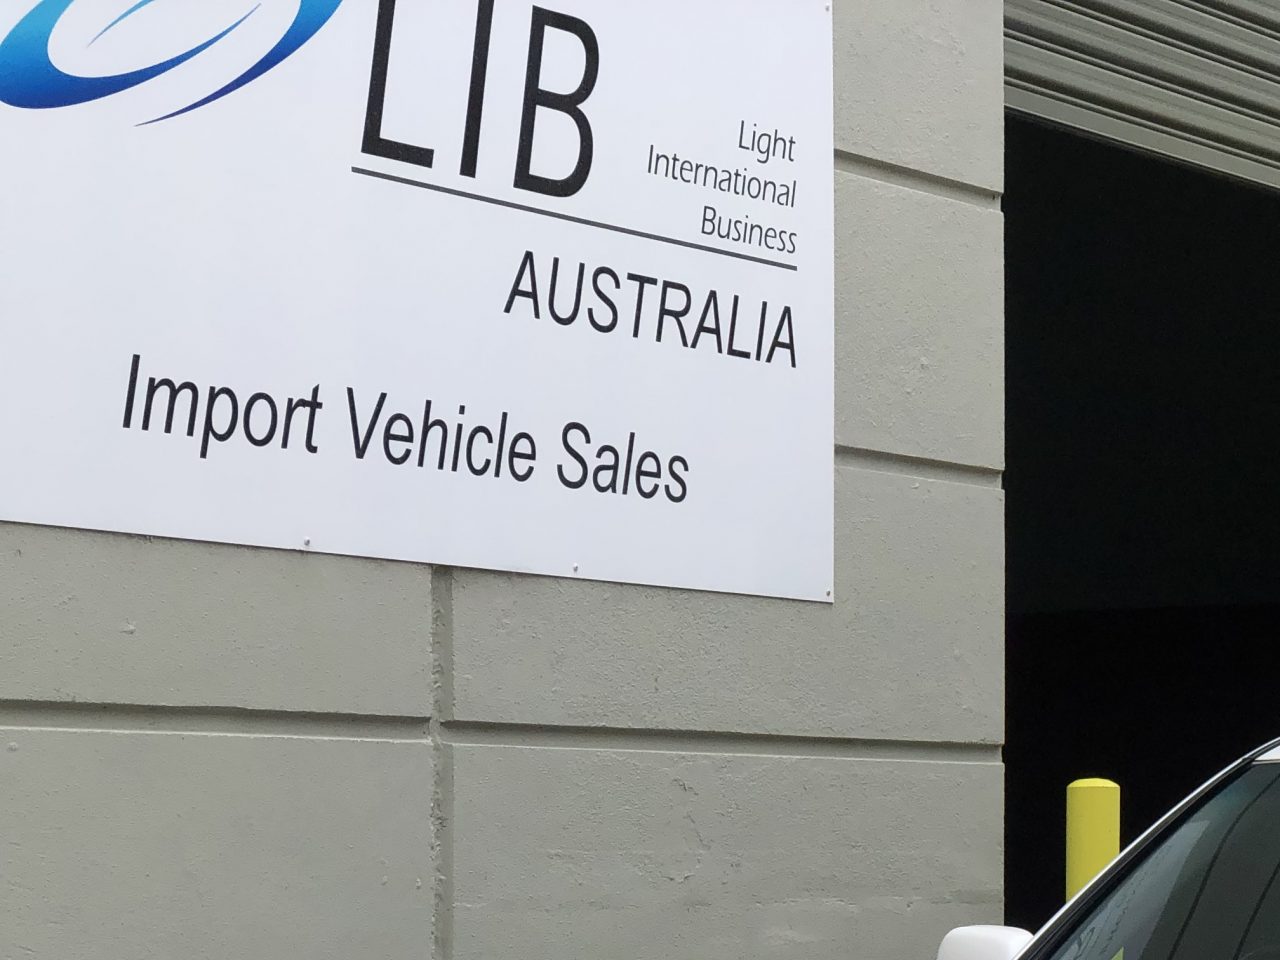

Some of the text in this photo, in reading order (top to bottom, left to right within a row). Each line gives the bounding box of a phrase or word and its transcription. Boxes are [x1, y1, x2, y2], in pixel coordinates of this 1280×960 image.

[361, 0, 600, 198] LIB
[738, 120, 797, 164] Light
[647, 144, 797, 208] International
[701, 205, 797, 256] Business
[503, 250, 797, 369] AUSTRALIA
[122, 353, 689, 504] Import Vehicle Sales
